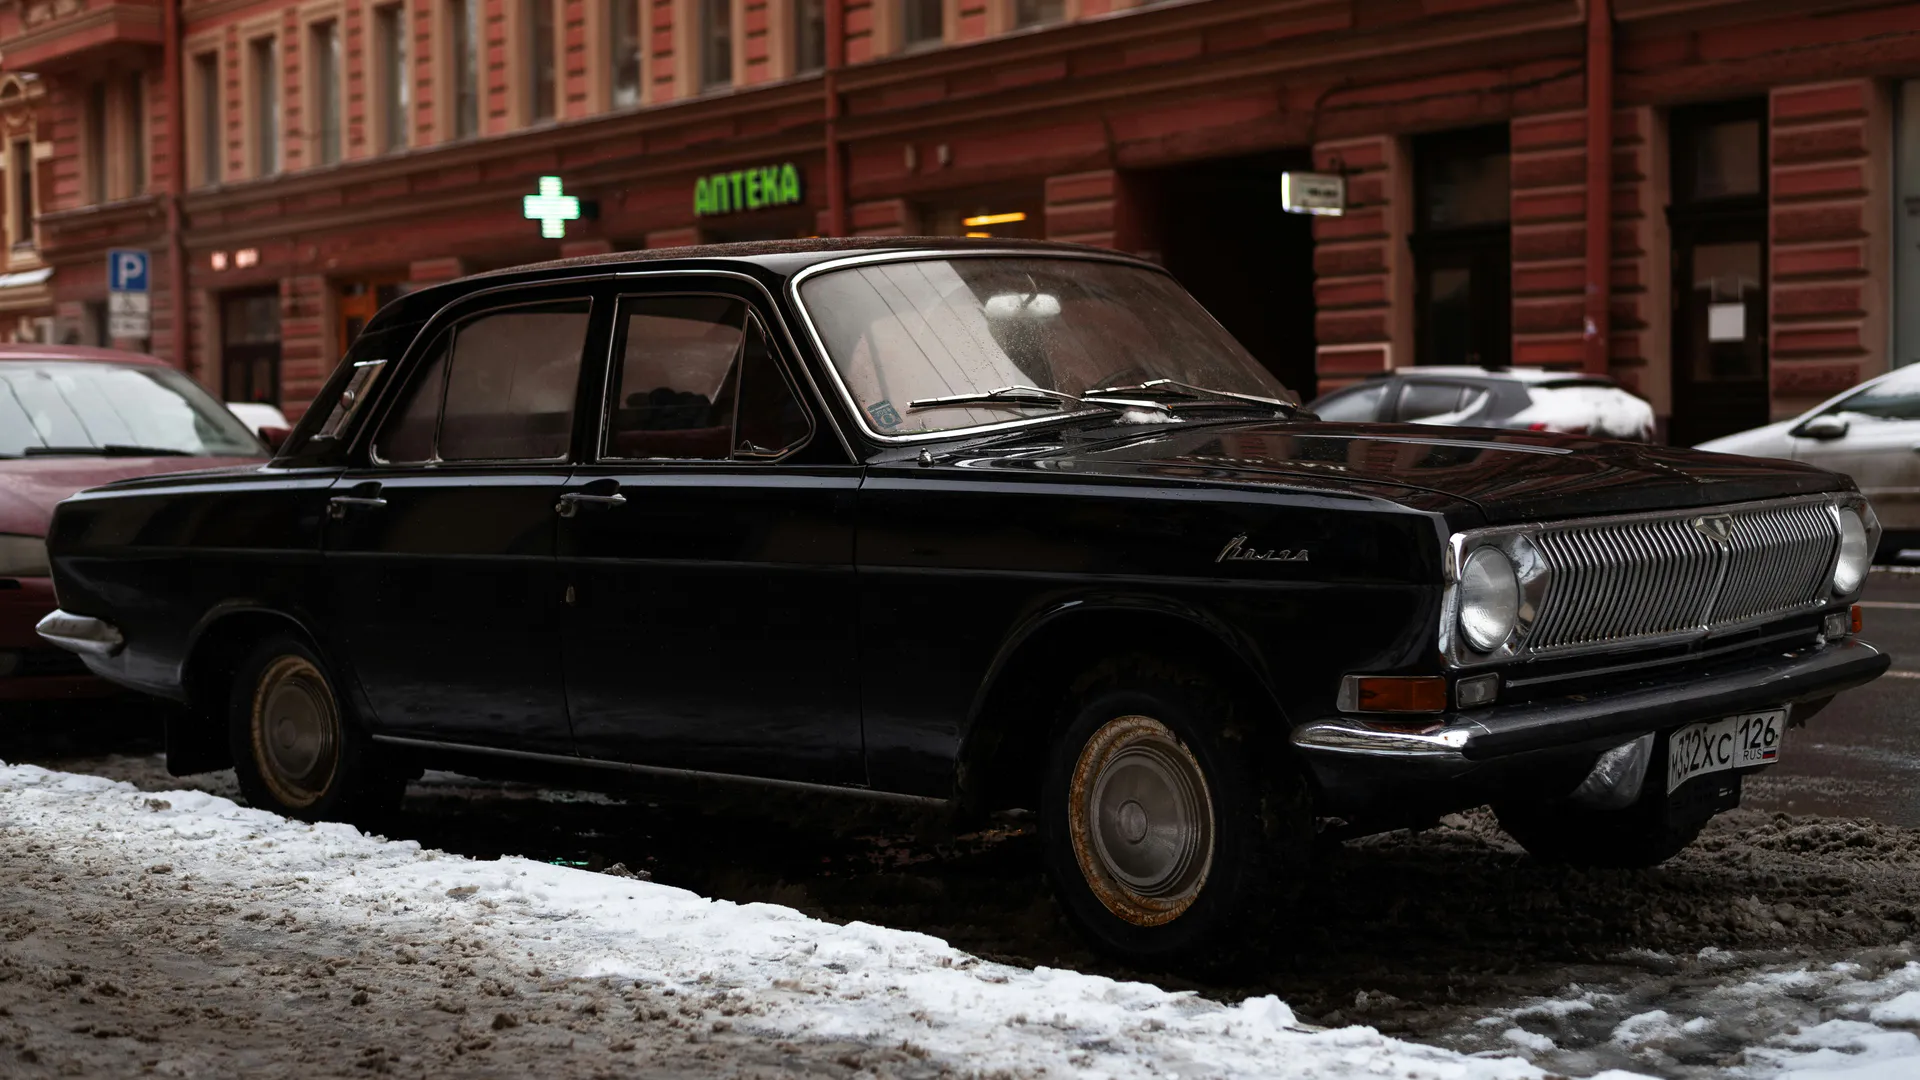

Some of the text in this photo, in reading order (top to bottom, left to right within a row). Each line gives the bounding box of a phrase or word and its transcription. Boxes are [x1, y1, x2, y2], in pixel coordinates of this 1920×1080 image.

[694, 162, 800, 216] АПТЕКА
[118, 253, 144, 290] P
[1739, 716, 1775, 750] 126
[1743, 748, 1762, 761] RUS
